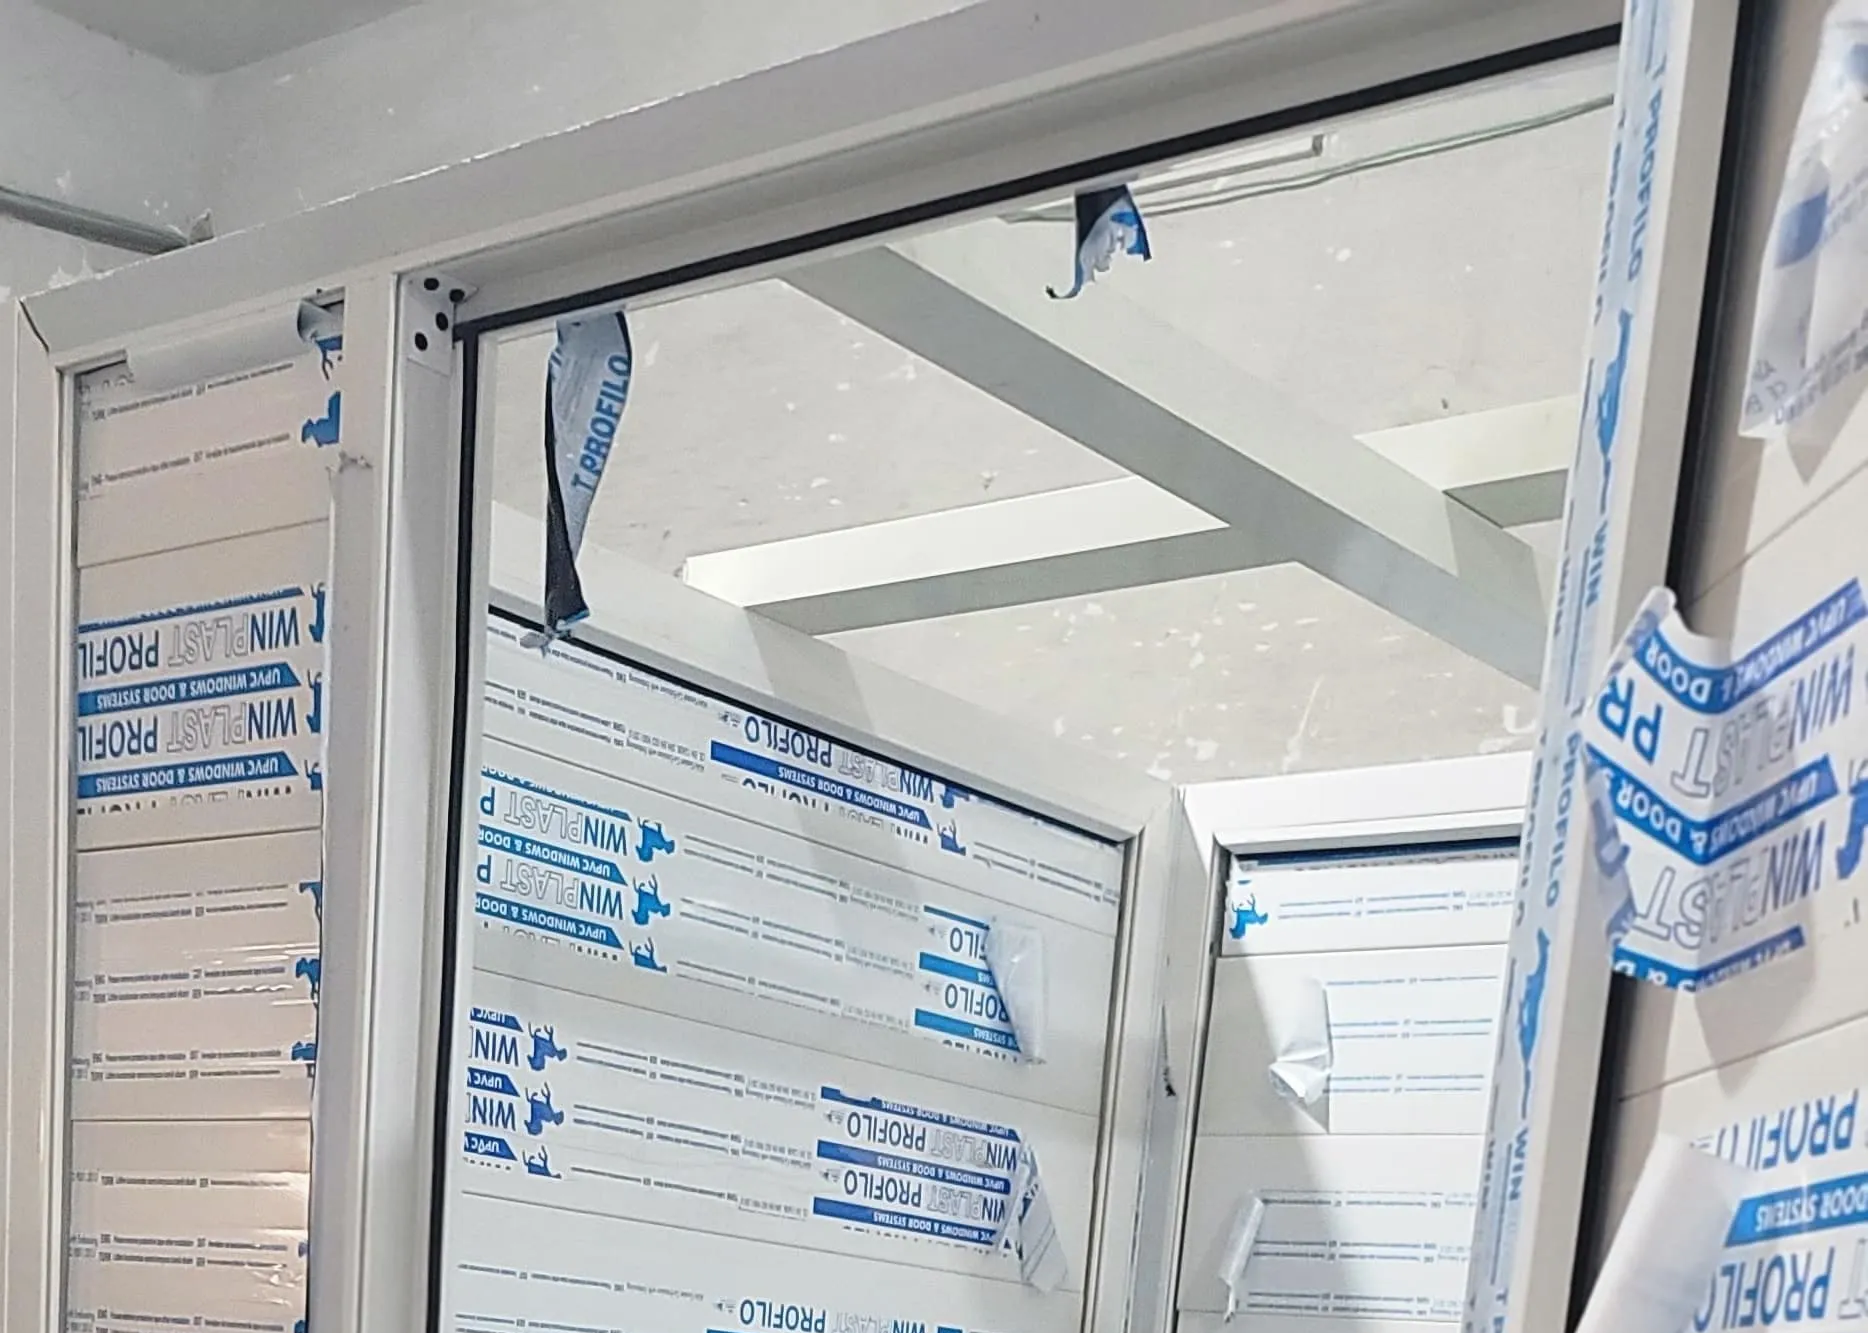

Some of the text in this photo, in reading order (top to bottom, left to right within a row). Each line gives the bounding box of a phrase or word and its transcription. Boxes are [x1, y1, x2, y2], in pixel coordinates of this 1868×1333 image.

[1628, 100, 1663, 281] PROFILO
[581, 354, 631, 480] PROFILO
[1644, 641, 1708, 702] DOOR
[745, 717, 832, 768] PROFILO
[480, 788, 496, 817] P
[1547, 730, 1581, 907] PROFILO
[1618, 783, 1681, 843] DOOR
[477, 855, 492, 883] P
[847, 1111, 925, 1150] PROFILO
[844, 1170, 922, 1209] PROFILO
[1756, 1194, 1815, 1231] SYSTEMS
[740, 1300, 826, 1333] PROFILO
